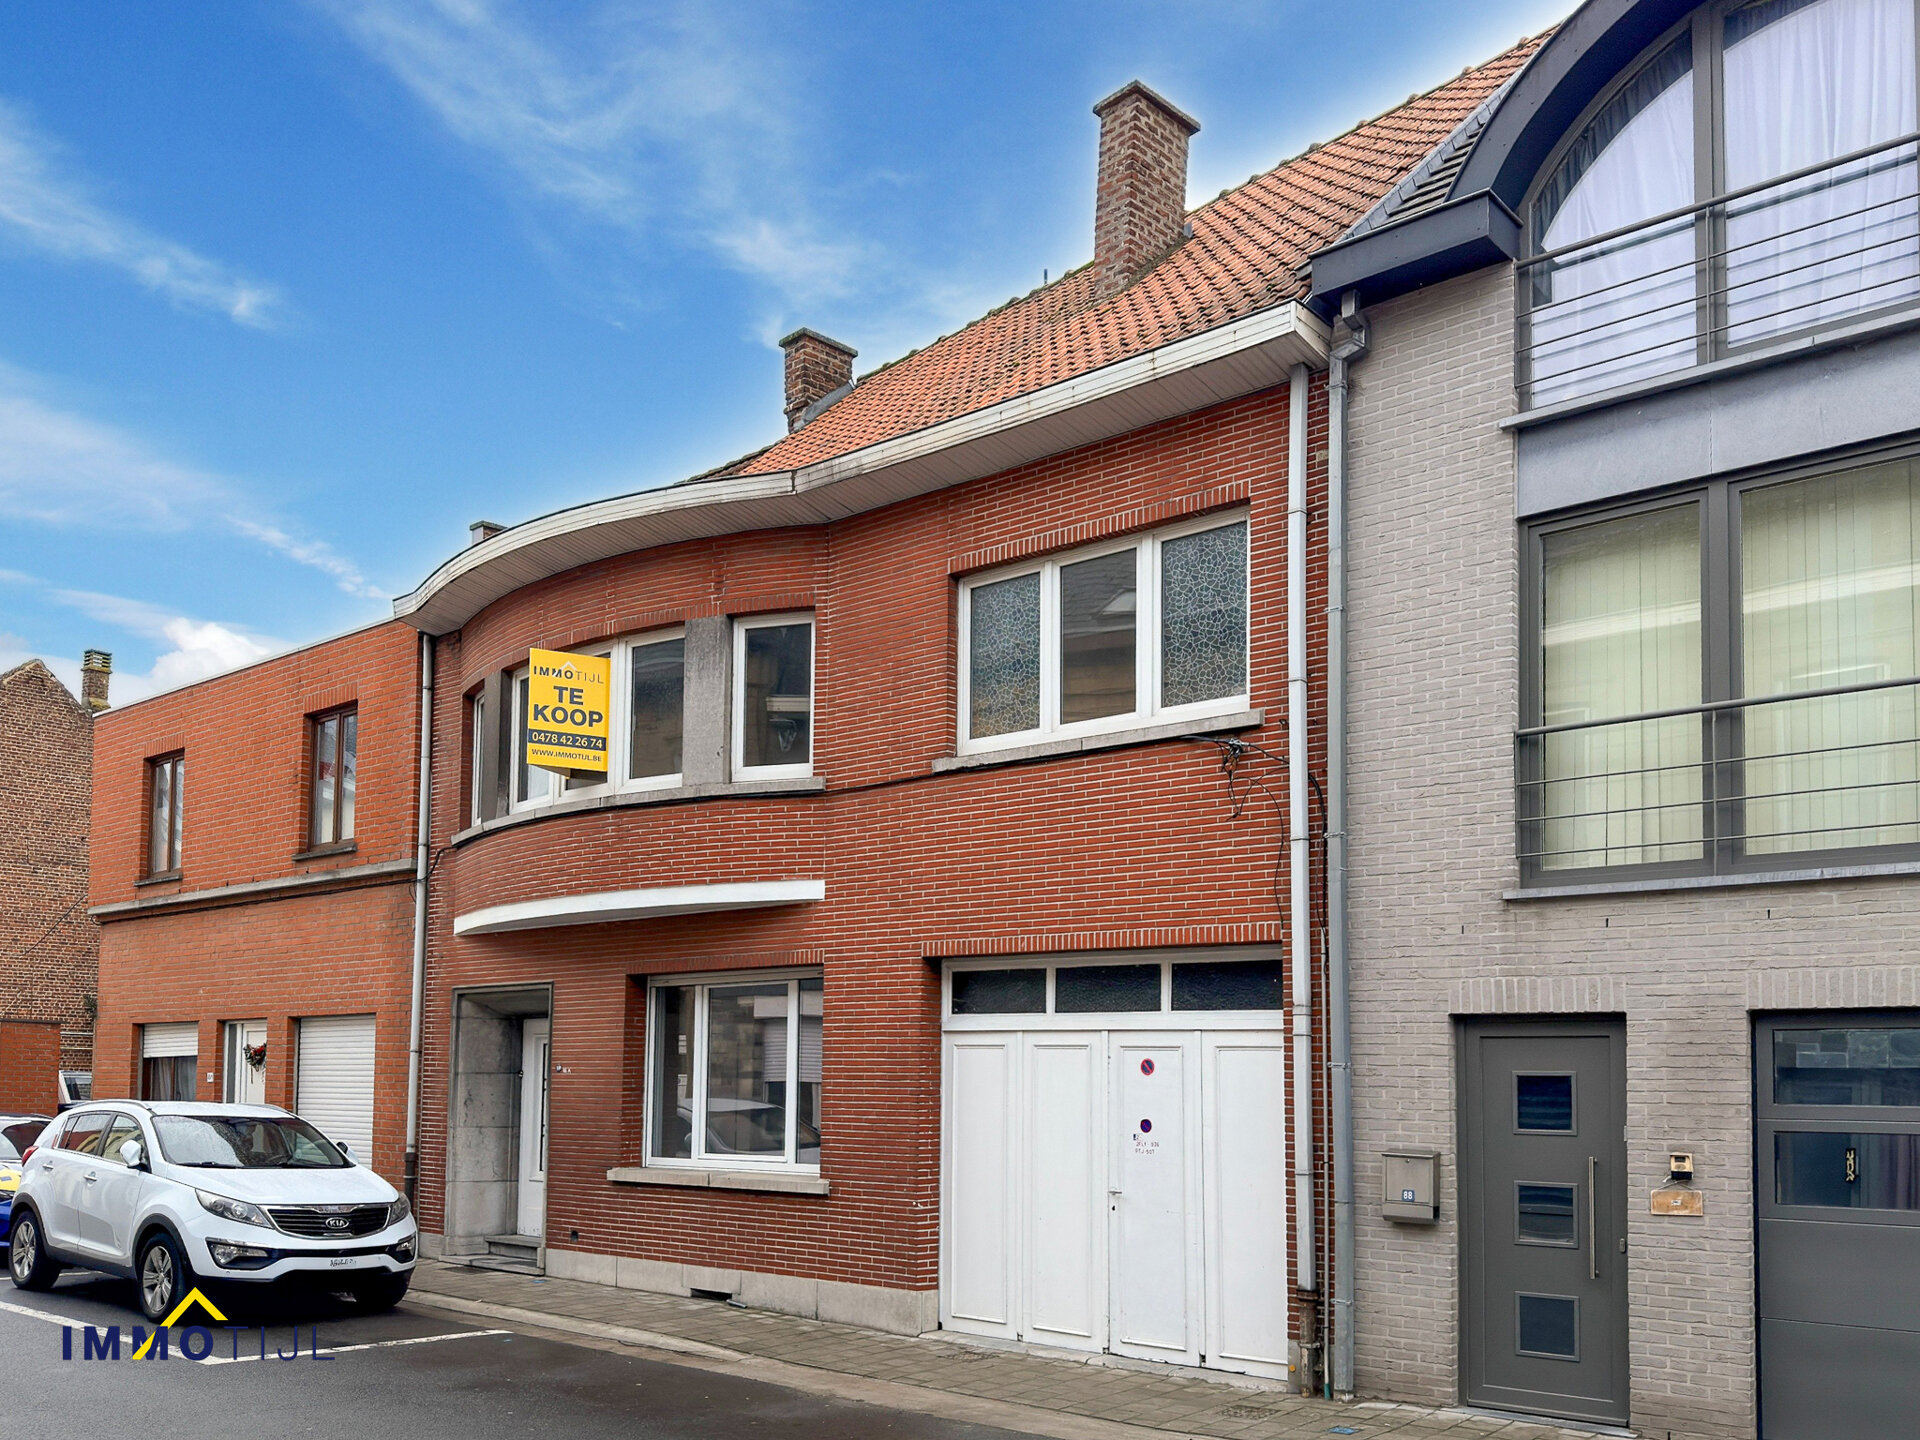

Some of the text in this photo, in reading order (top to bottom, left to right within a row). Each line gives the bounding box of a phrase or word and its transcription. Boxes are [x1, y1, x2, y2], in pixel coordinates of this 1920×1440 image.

[533, 665, 604, 684] IMMOTIJL
[553, 685, 584, 706] TE
[533, 703, 603, 728] KOOP
[532, 731, 603, 749] 0478 42 26 74
[531, 748, 602, 762] WWW.IMMOTIJL.BE
[1403, 1190, 1413, 1200] 88
[329, 1219, 345, 1227] KIA
